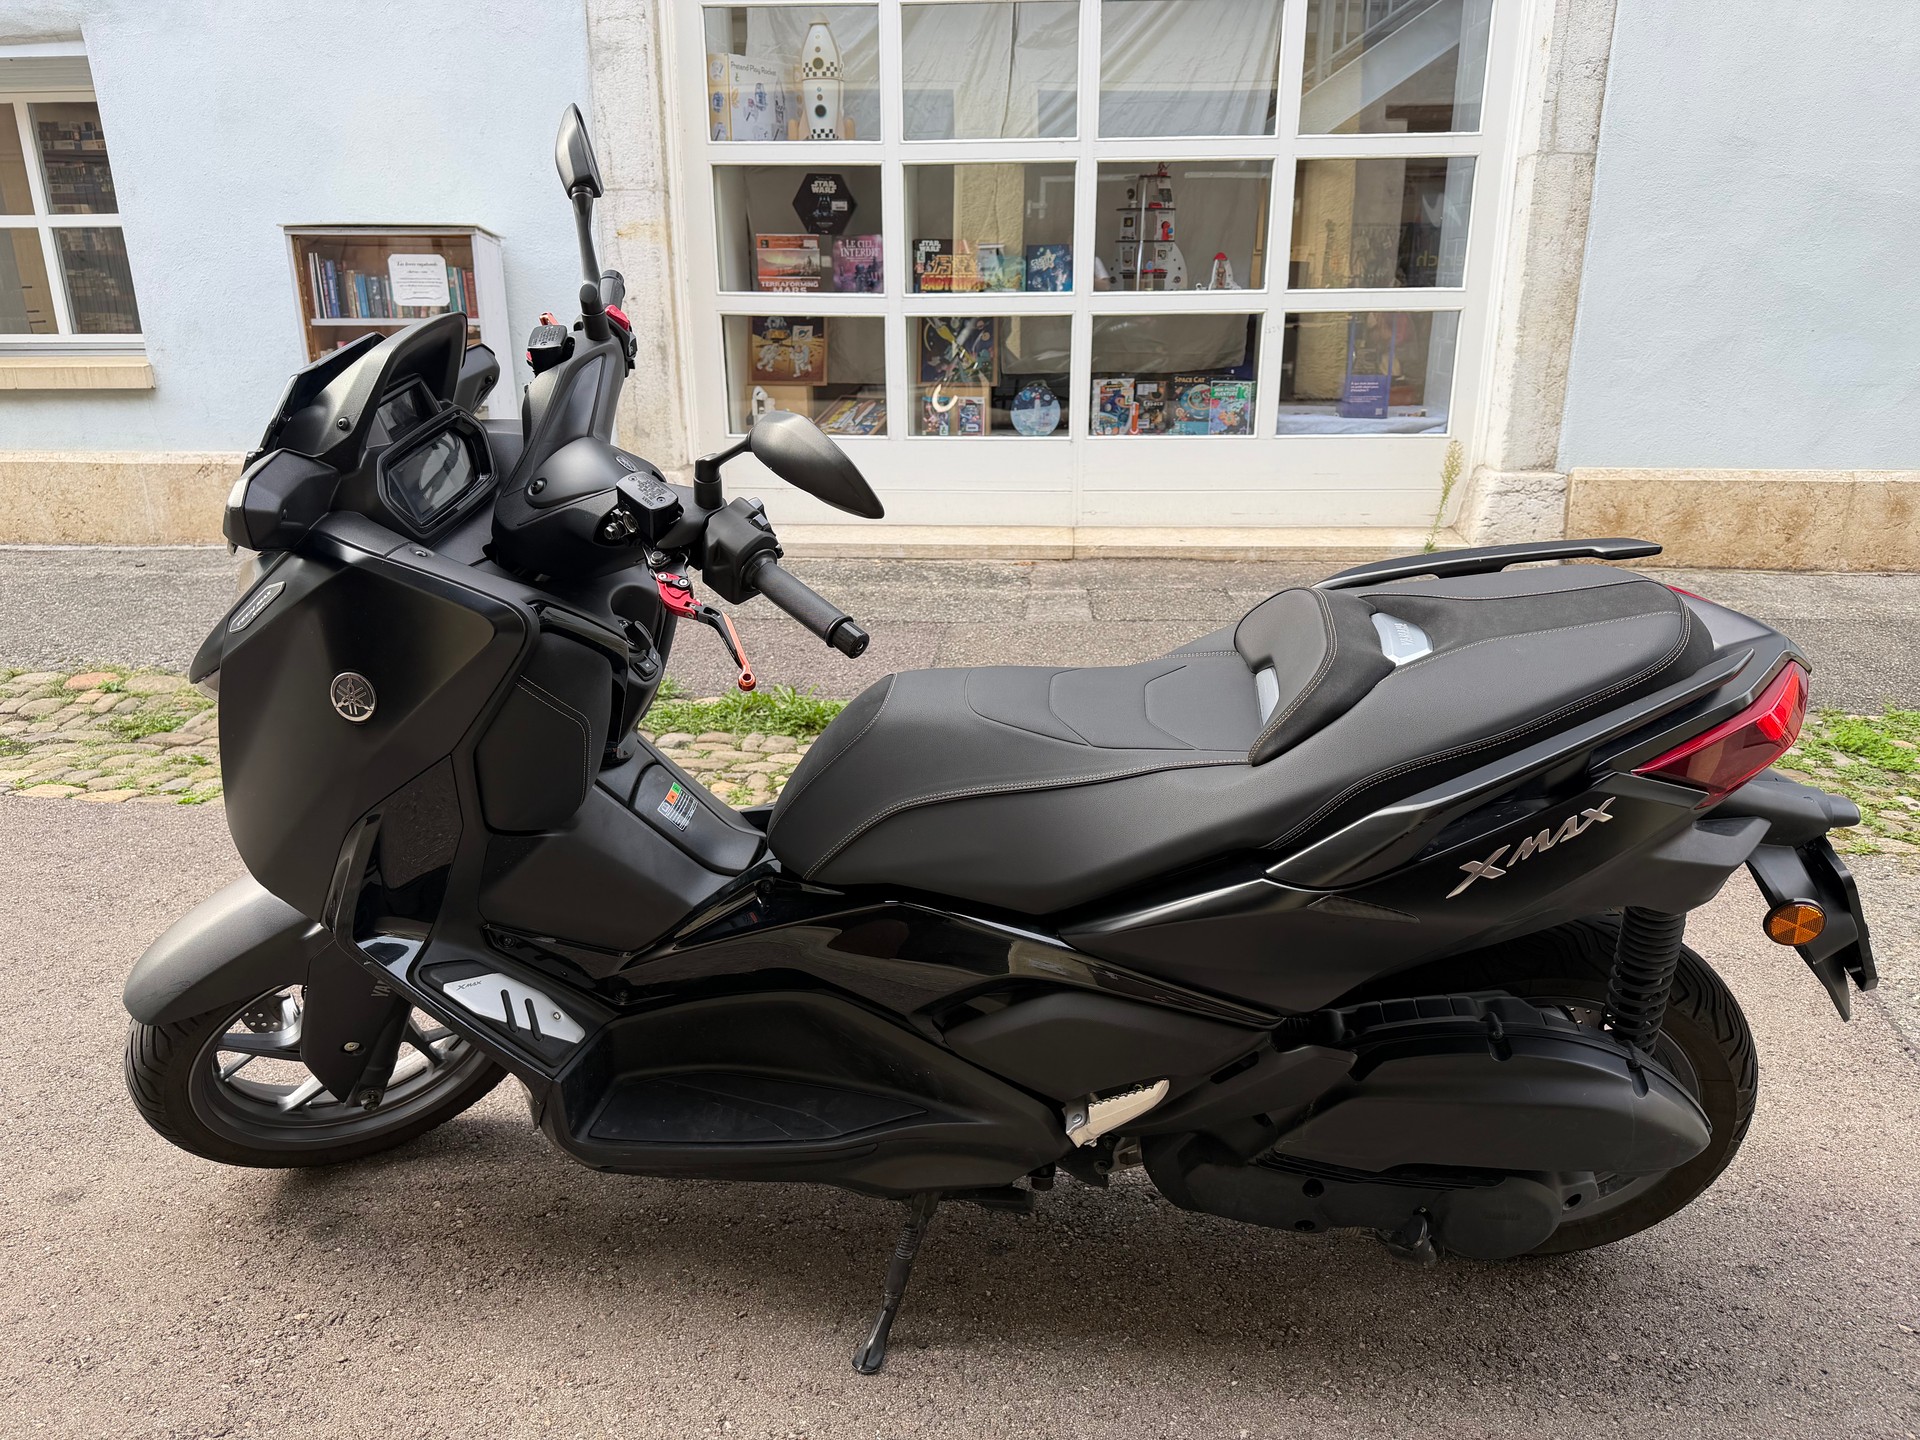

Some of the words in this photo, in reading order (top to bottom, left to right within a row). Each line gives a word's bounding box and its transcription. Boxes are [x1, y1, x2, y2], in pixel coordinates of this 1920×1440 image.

[846, 240, 856, 248] LE
[857, 240, 874, 248] CIEL
[840, 247, 880, 257] INTERDIT
